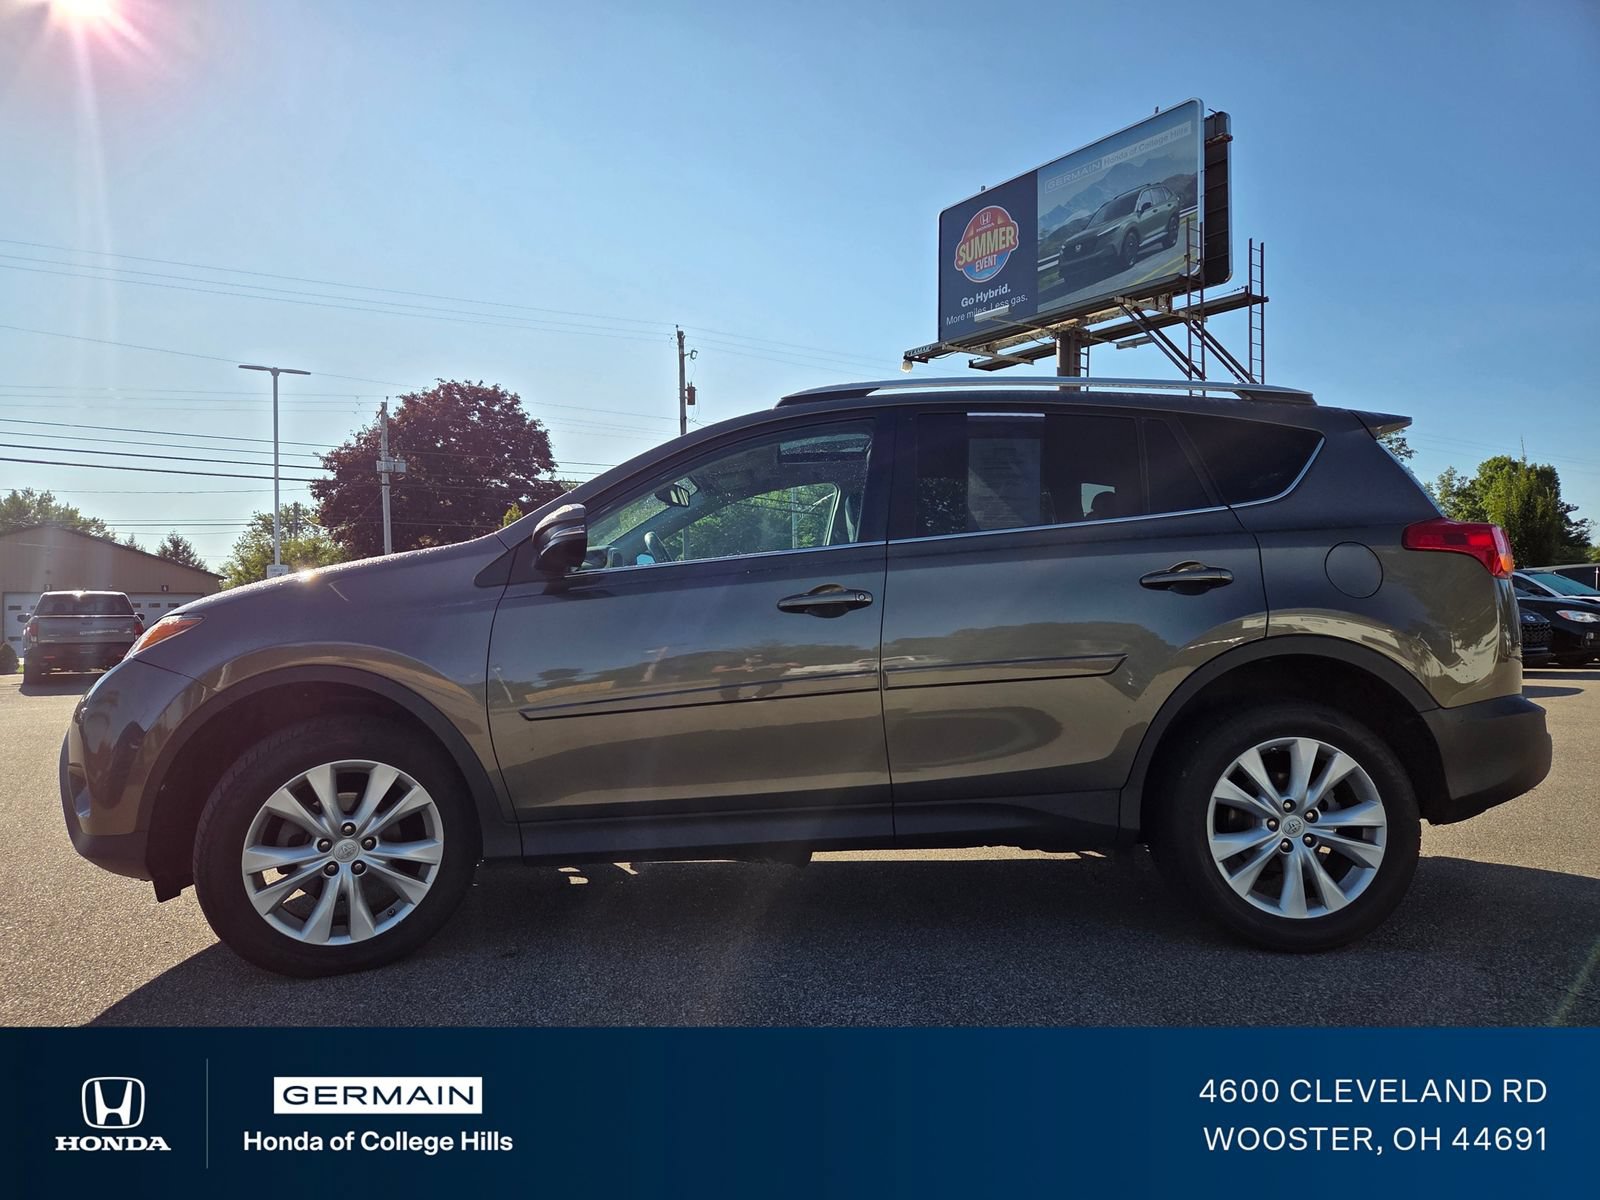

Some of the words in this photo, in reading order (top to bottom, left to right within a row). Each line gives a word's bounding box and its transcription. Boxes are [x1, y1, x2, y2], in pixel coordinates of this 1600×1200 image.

[1047, 160, 1101, 189] GERMAIN
[1105, 150, 1128, 167] Honda
[958, 225, 1015, 266] SUMMER
[975, 254, 998, 273] EVENT
[946, 314, 965, 327] More
[1010, 293, 1028, 307] gas.
[961, 297, 975, 308] Go
[975, 283, 1011, 304] Hybrid.
